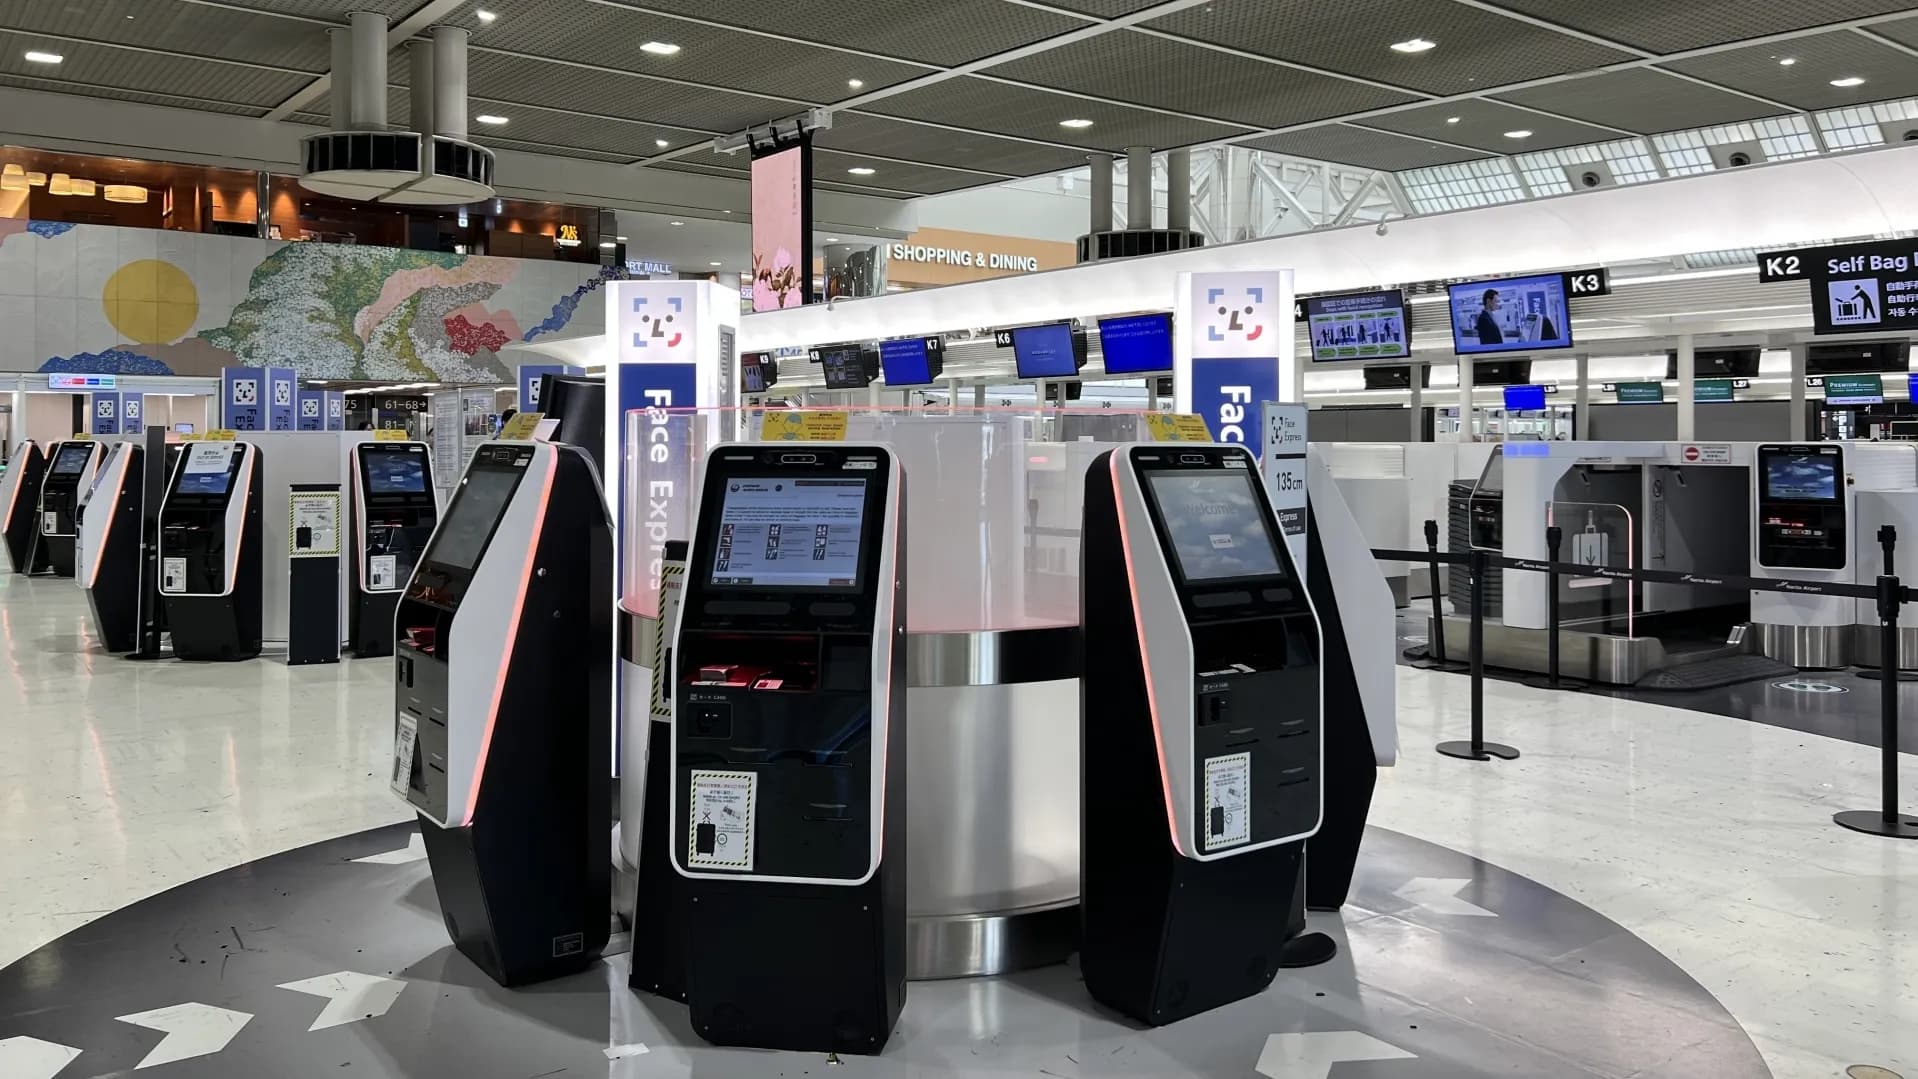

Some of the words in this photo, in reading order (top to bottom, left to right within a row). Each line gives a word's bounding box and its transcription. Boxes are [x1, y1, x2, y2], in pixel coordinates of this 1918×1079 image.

[893, 243, 973, 266] SHOPPING
[975, 253, 986, 268] &
[990, 253, 1038, 272] DINING
[644, 262, 672, 274] MALL
[1766, 256, 1801, 277] K2
[1827, 254, 1865, 274] Self
[1869, 256, 1908, 272] Bag
[1571, 274, 1600, 293] K3
[926, 338, 939, 351] K7
[997, 333, 1011, 345] K6
[759, 353, 769, 364] K9
[810, 351, 820, 362] K8
[644, 389, 672, 464] Face
[1285, 417, 1296, 428] Face
[1285, 431, 1302, 443] Express
